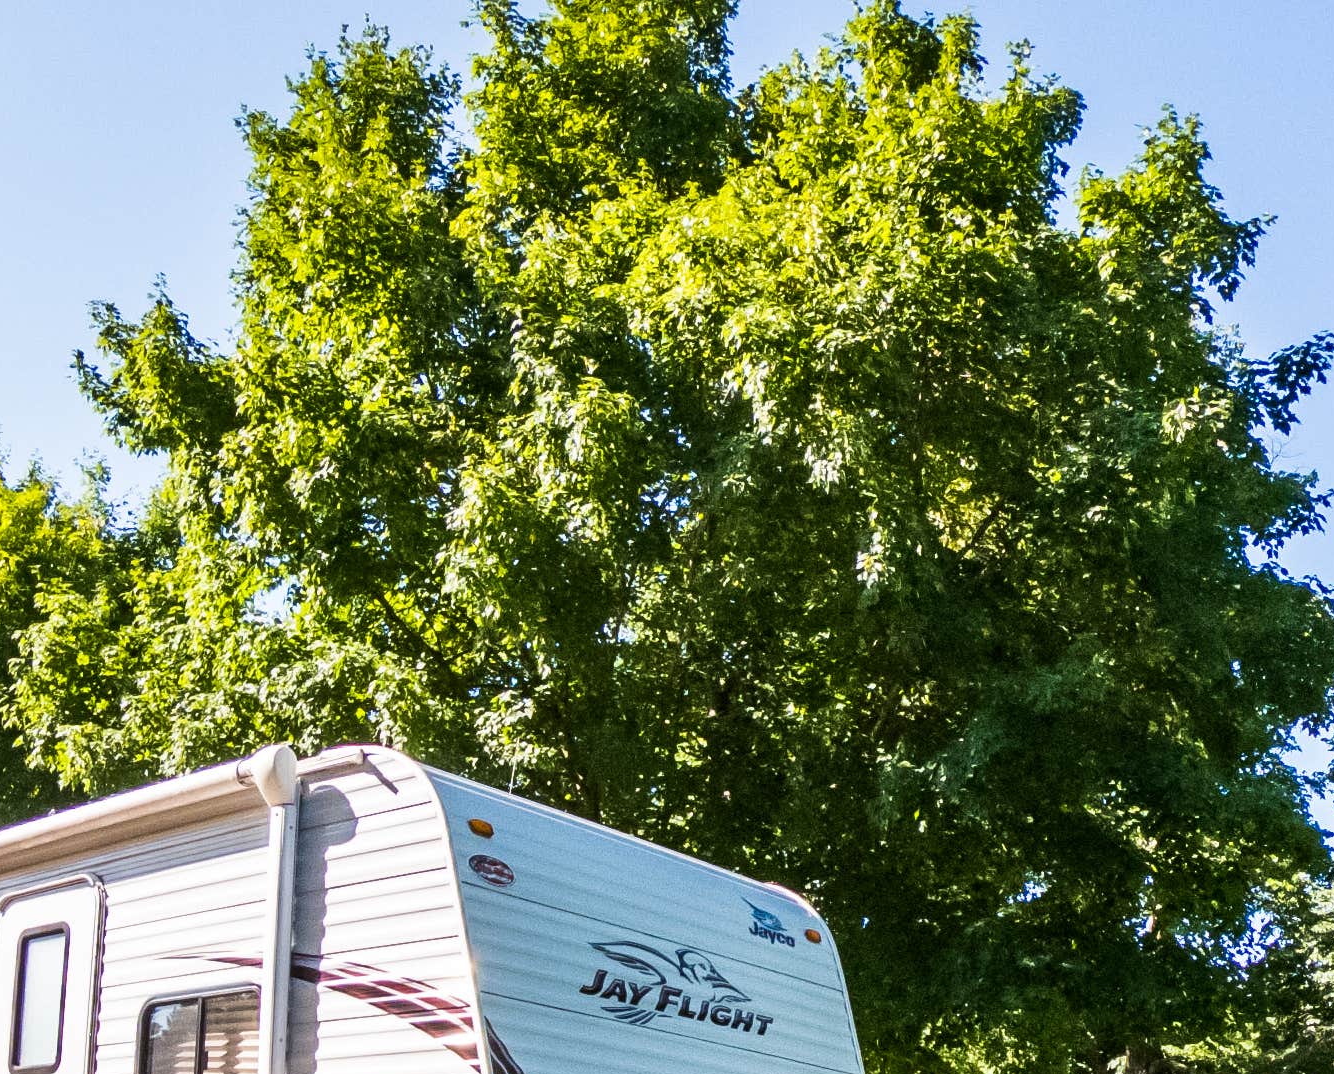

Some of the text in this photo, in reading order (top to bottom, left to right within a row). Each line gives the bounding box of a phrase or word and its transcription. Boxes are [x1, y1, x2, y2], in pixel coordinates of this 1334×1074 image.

[749, 921, 795, 947] Jayco
[579, 968, 774, 1036] JAY FLIGHT
